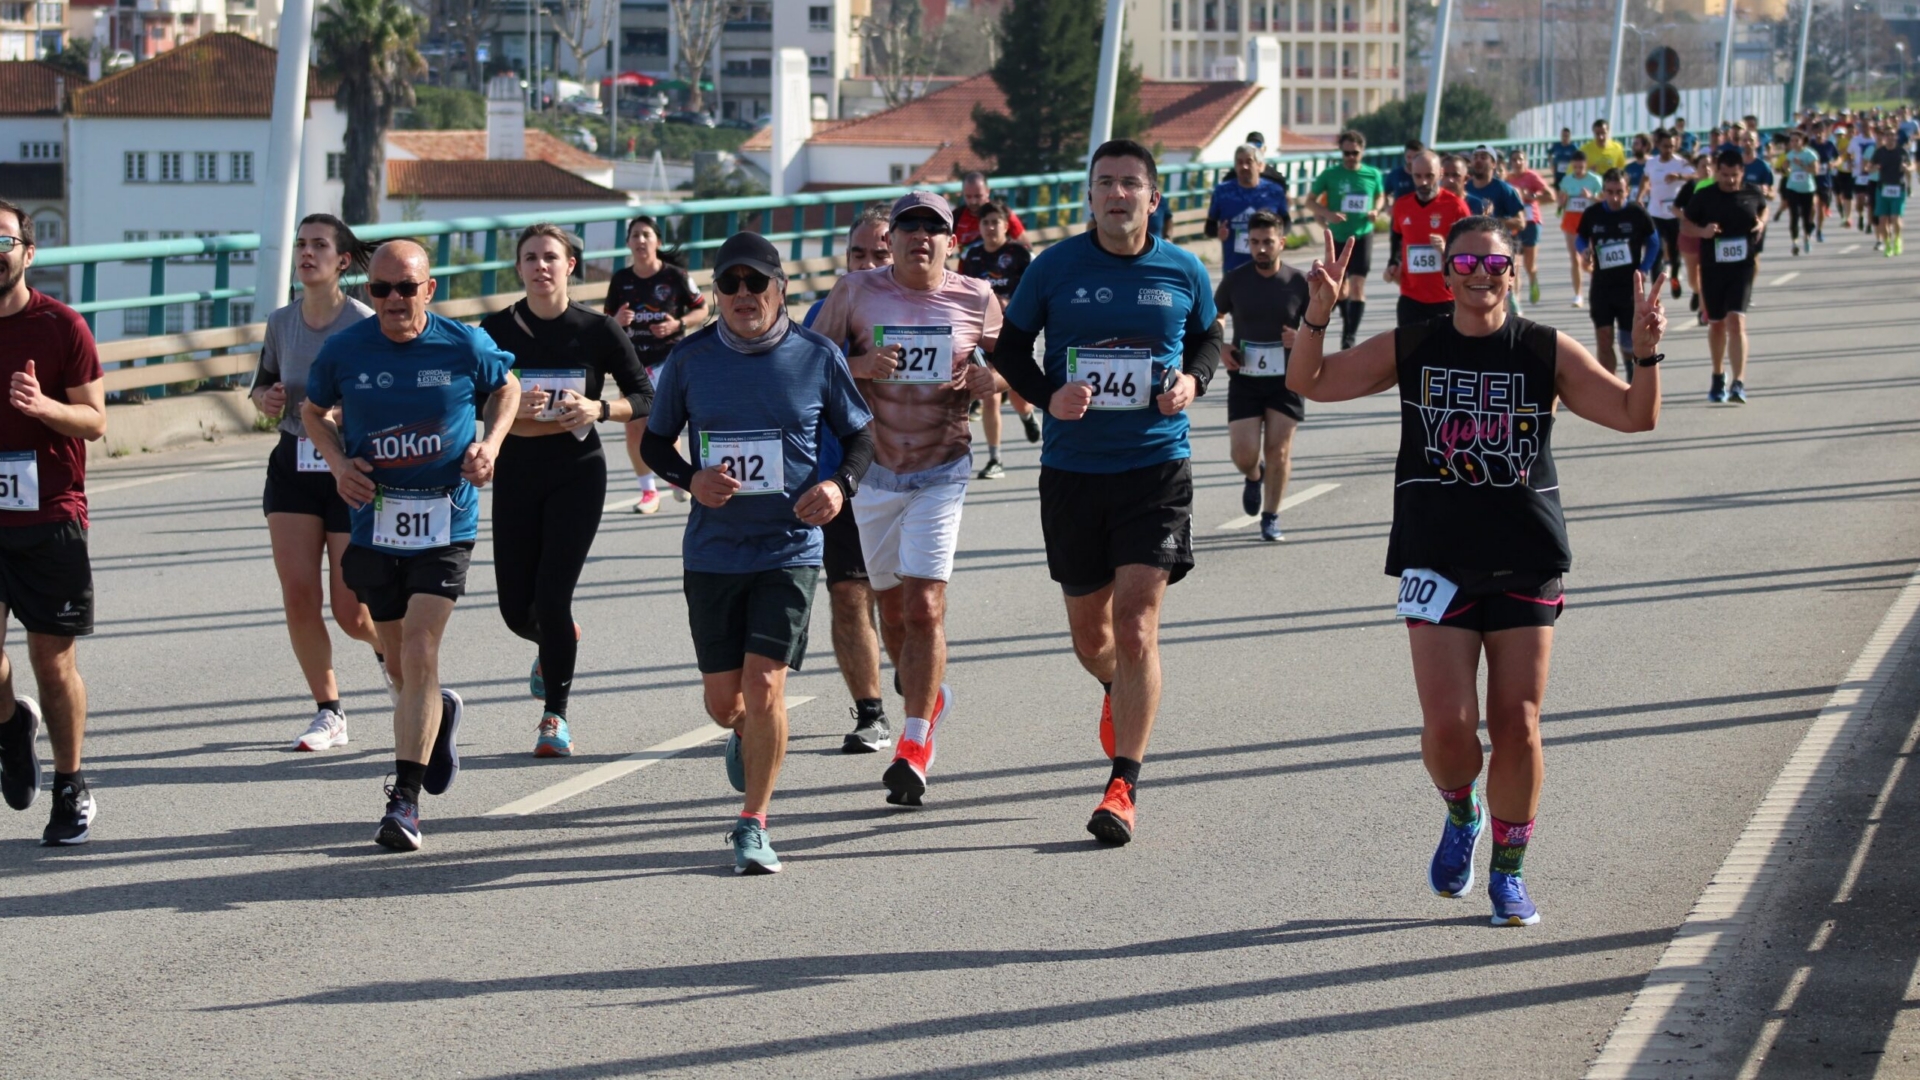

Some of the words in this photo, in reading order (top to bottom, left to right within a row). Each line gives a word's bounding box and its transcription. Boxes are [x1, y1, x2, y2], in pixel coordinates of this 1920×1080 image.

[1413, 254, 1436, 267] 458
[1605, 250, 1625, 262] 403
[1723, 245, 1742, 258] 805
[1068, 363, 1074, 371] C
[1258, 355, 1267, 370] 6
[1087, 371, 1136, 397] 346
[1421, 366, 1539, 415] FEEL
[1420, 408, 1539, 456] YOUR
[372, 432, 441, 460] 10Km
[702, 447, 708, 456] C
[1425, 447, 1537, 487] BODY
[396, 512, 430, 537] 811
